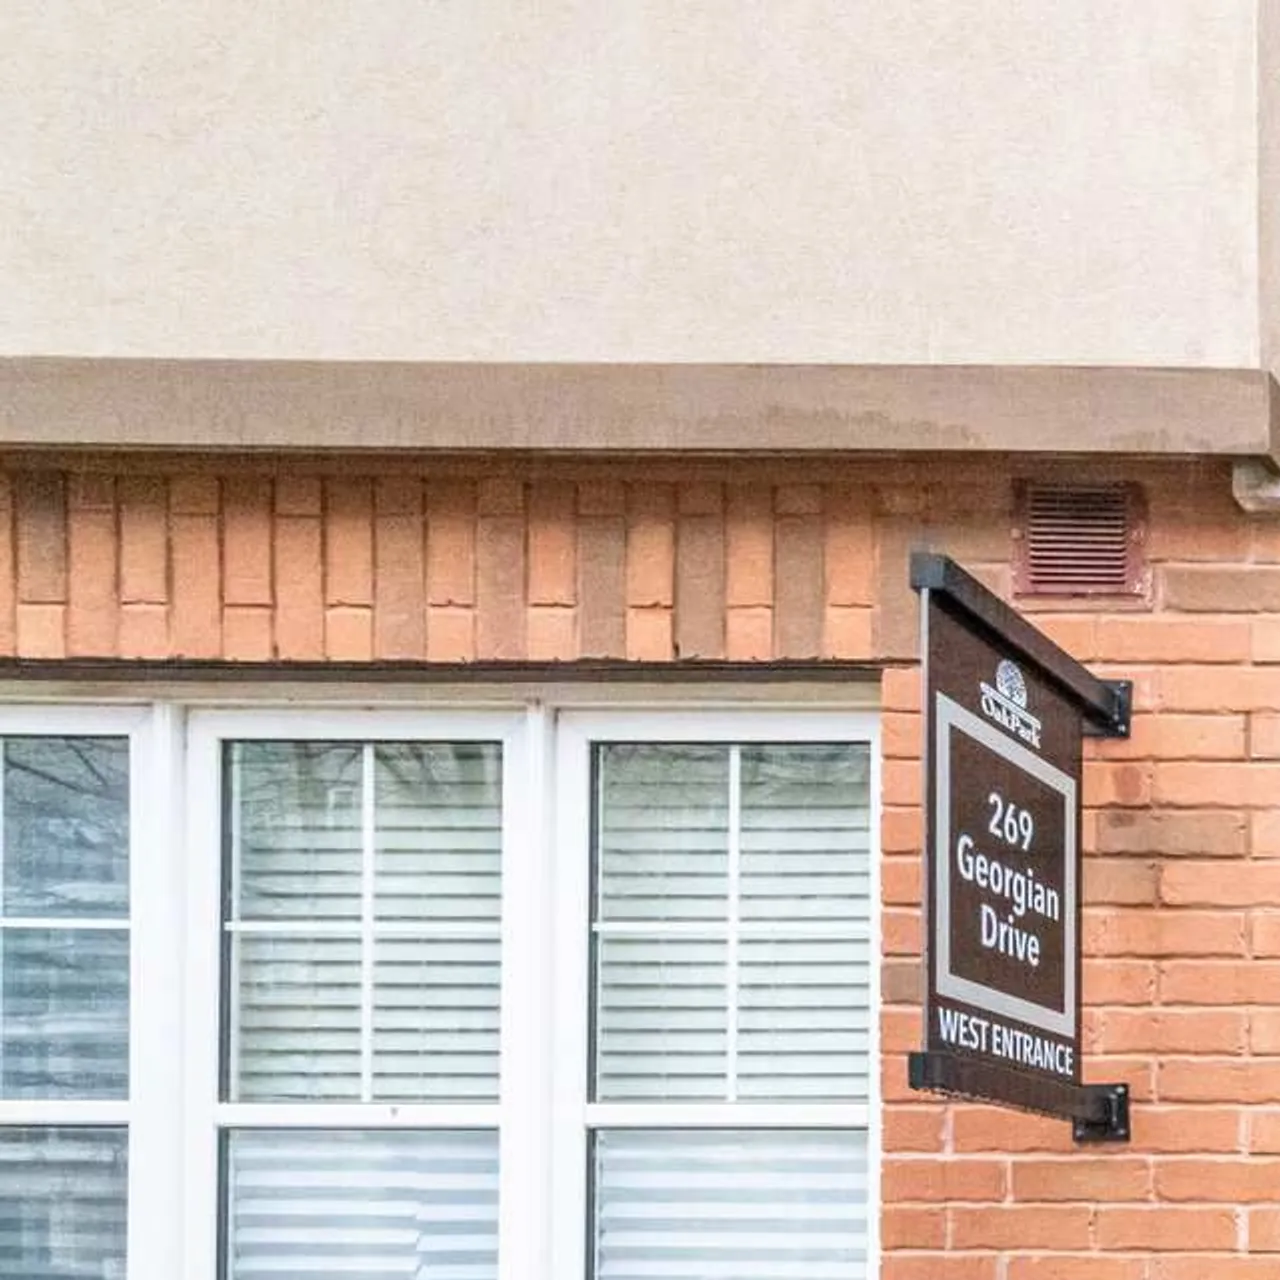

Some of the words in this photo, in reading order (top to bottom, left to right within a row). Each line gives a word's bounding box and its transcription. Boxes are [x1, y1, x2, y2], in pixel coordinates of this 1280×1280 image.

[988, 791, 1033, 851] 269
[957, 834, 1059, 921] Georgian
[980, 903, 1040, 967] Drive
[938, 1006, 990, 1052] WEST
[992, 1023, 1074, 1076] ENTRANCE
